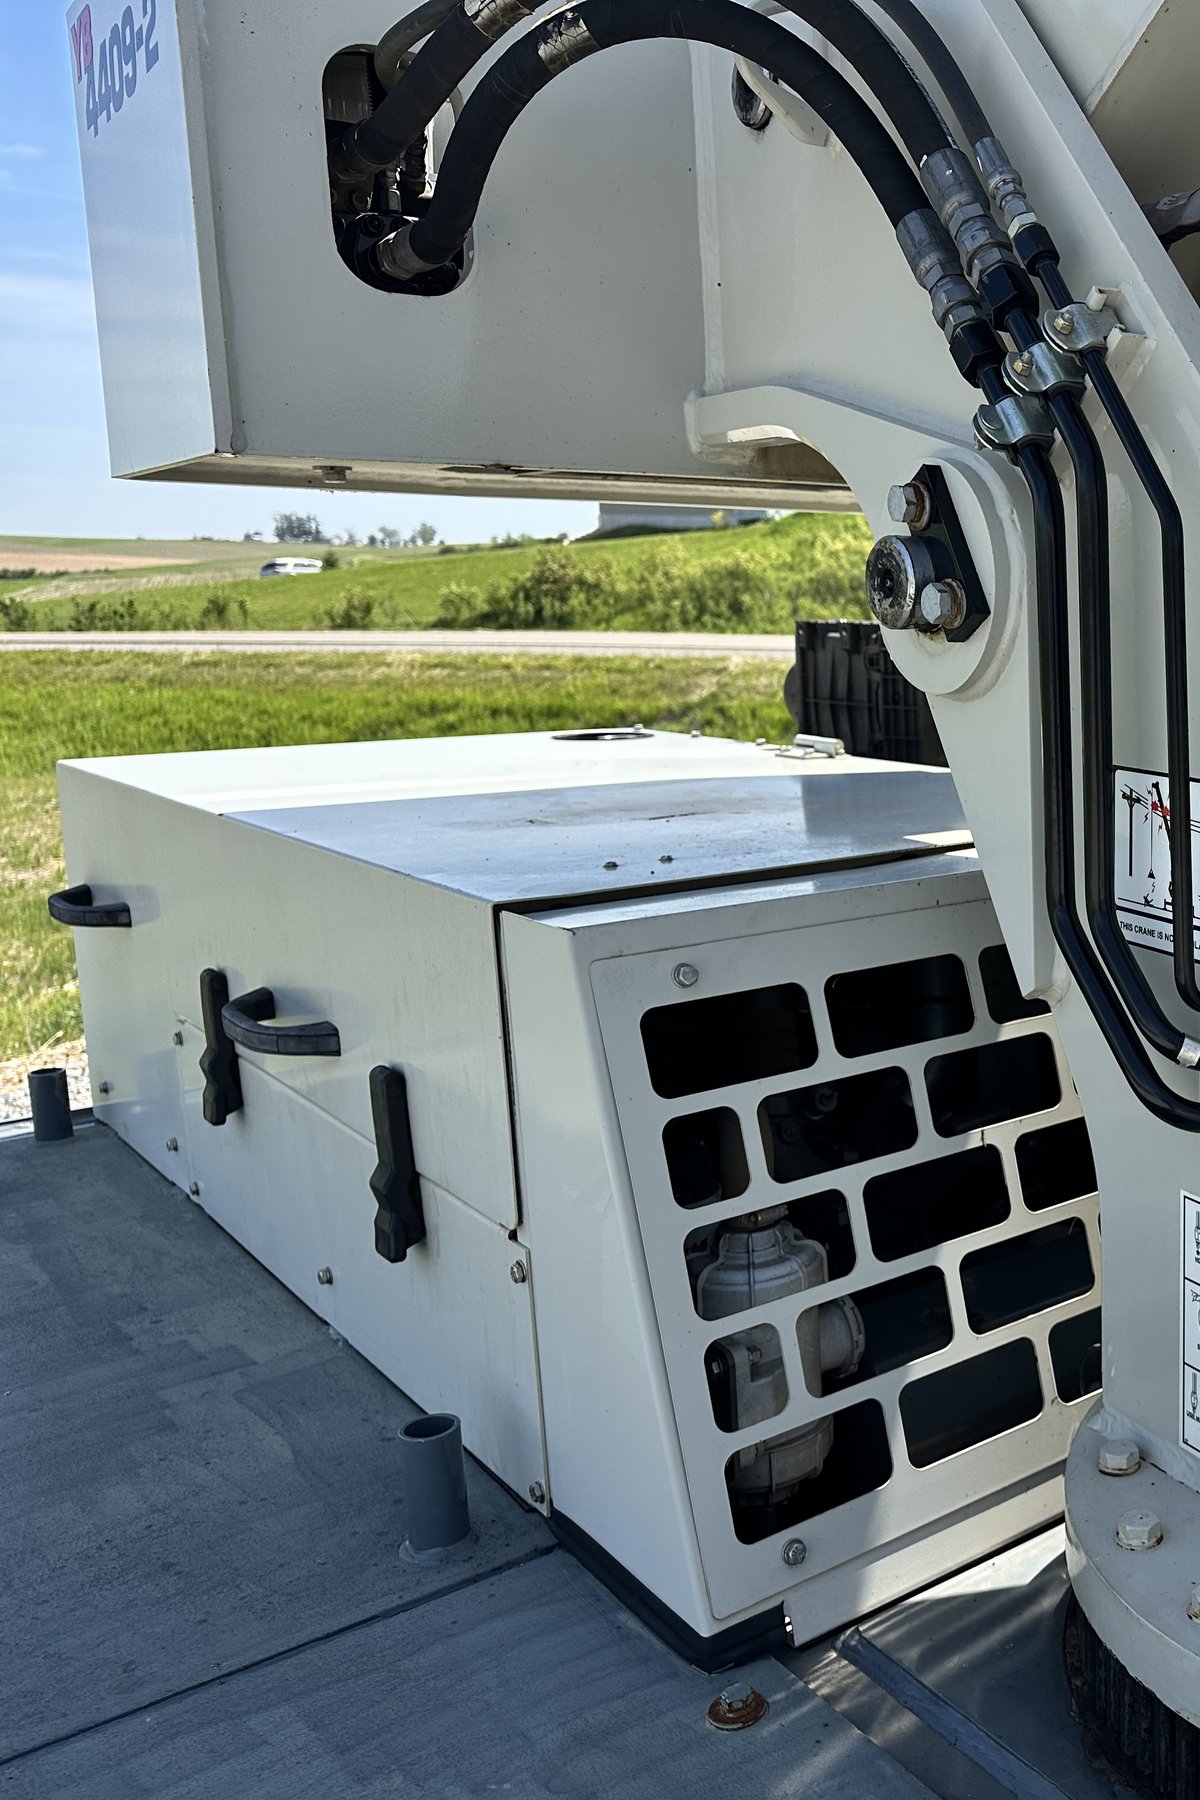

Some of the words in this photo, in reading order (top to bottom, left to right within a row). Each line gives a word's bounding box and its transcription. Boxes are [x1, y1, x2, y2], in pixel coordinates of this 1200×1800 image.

[86, 0, 159, 138] 4409-2
[1120, 921, 1133, 931] THIS
[1134, 925, 1155, 938] CRANE
[1157, 931, 1163, 940] IS
[1165, 933, 1174, 942] NO
